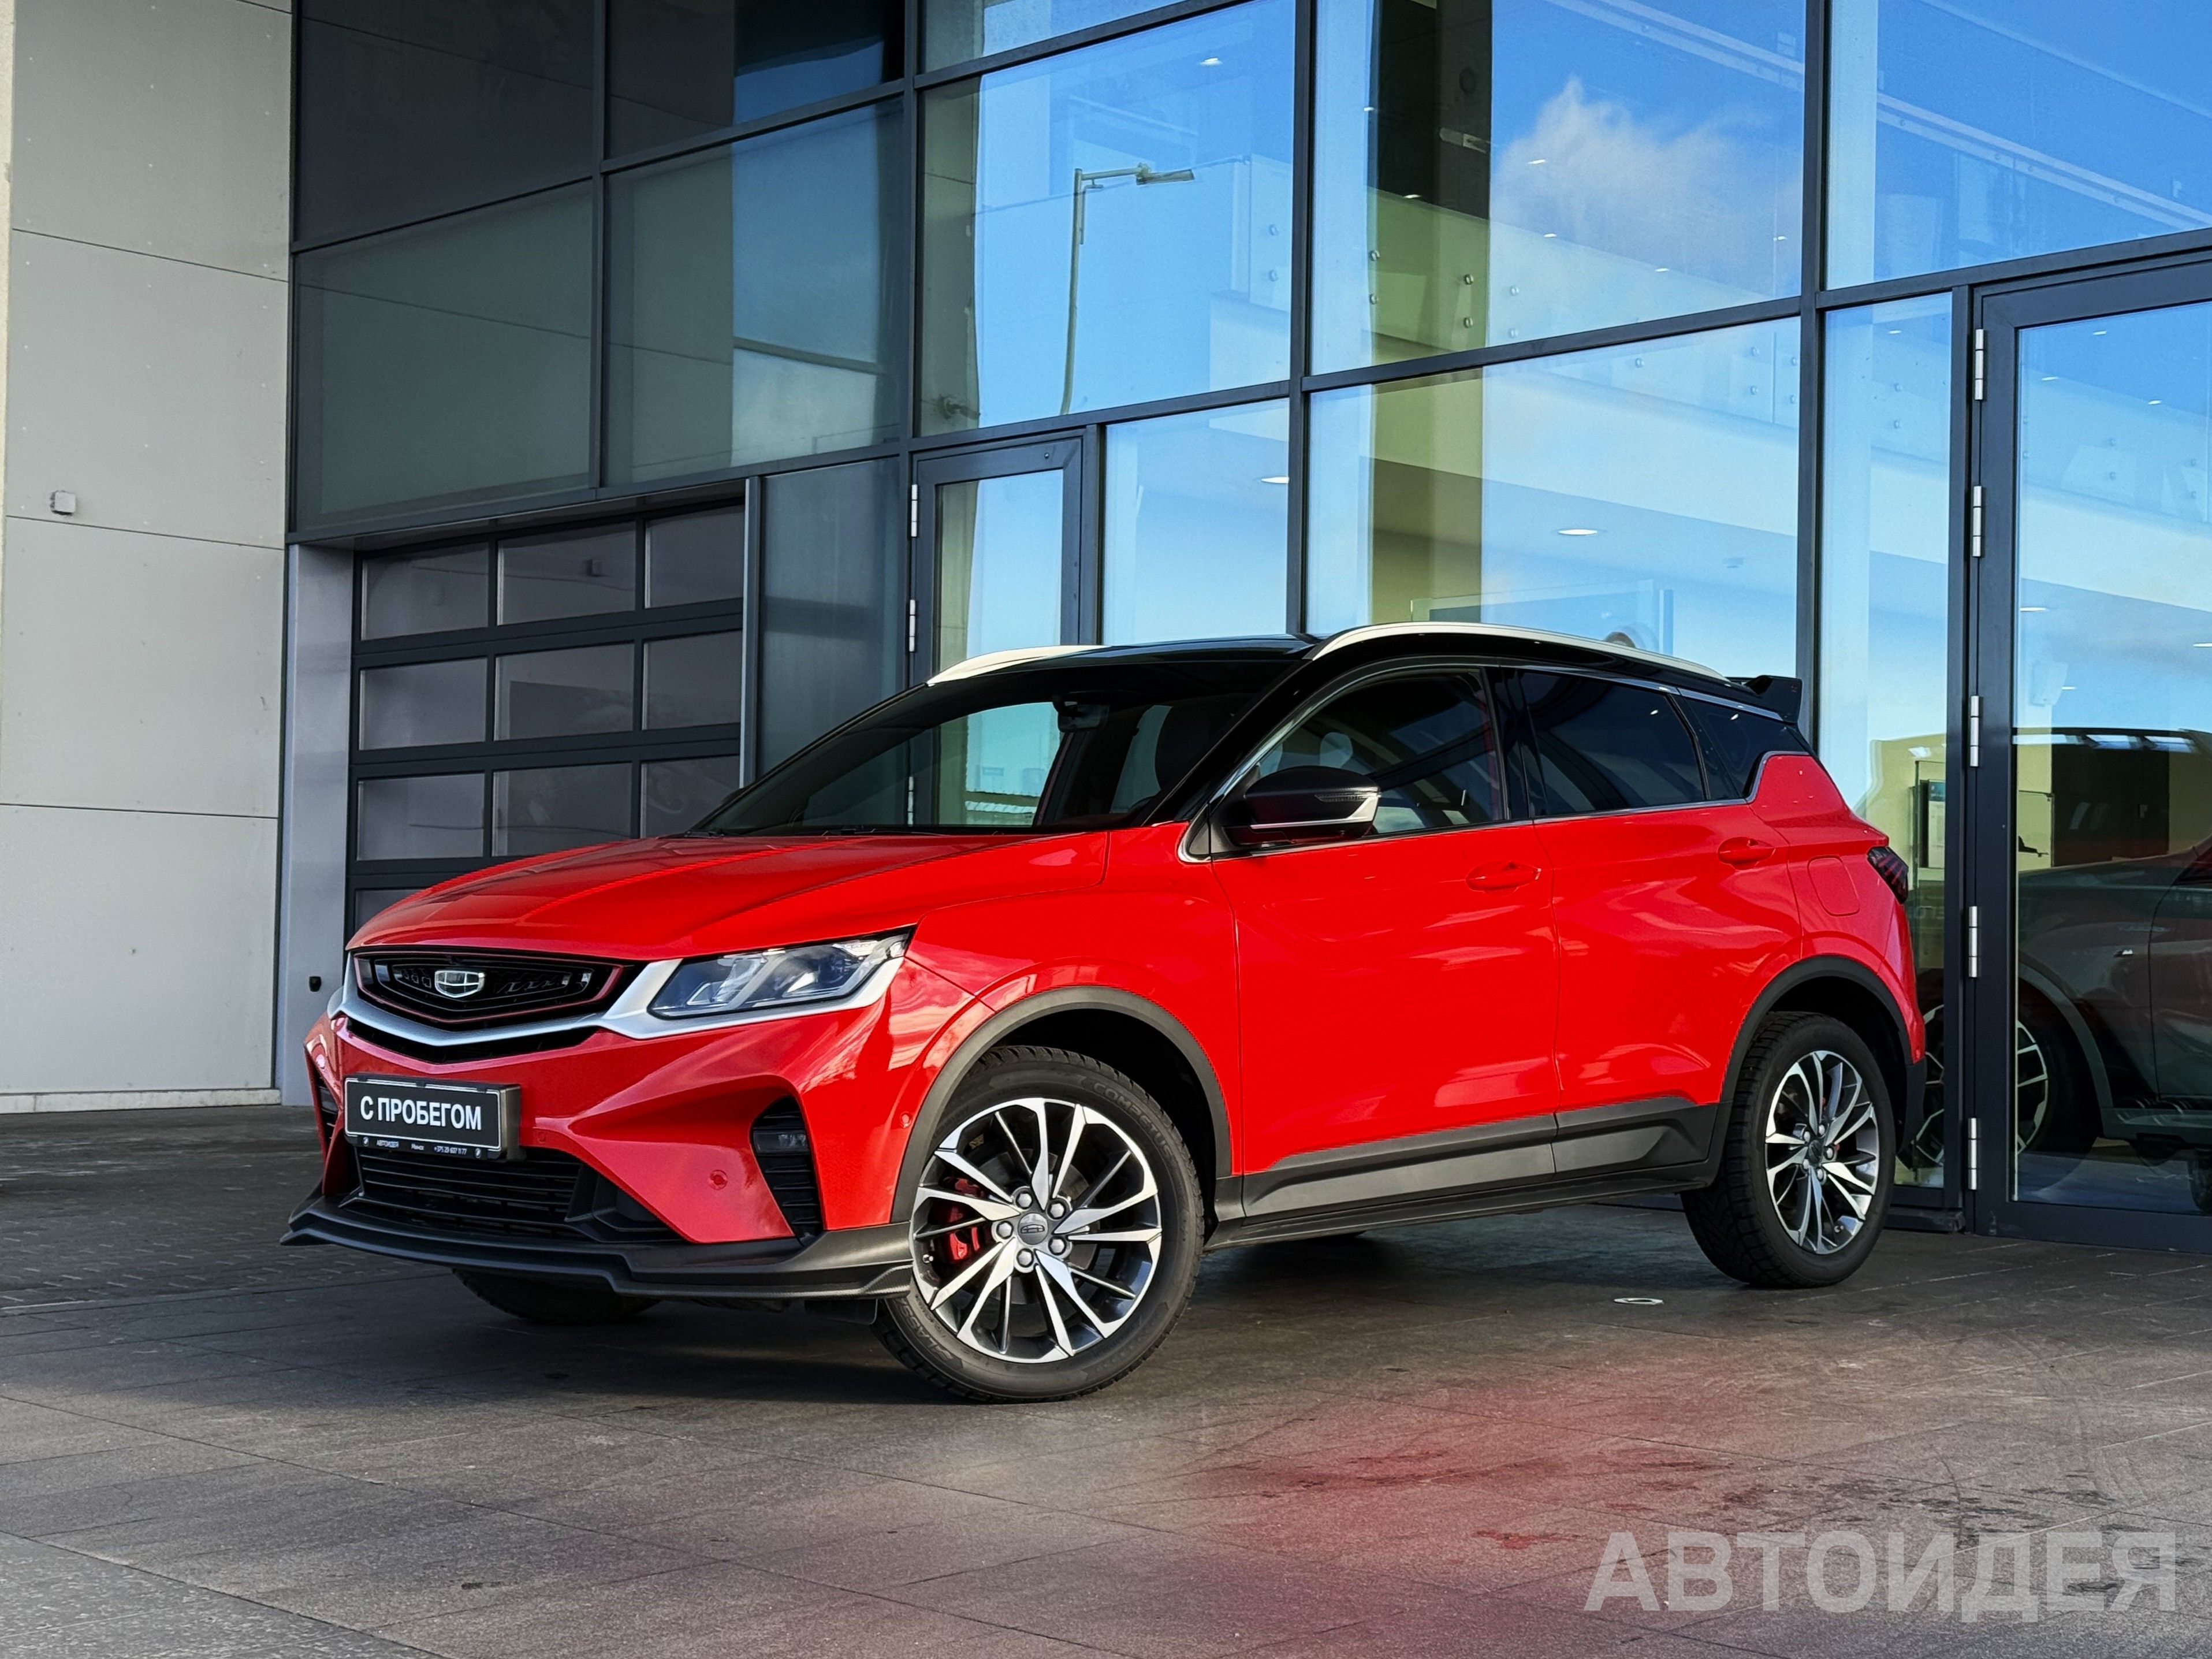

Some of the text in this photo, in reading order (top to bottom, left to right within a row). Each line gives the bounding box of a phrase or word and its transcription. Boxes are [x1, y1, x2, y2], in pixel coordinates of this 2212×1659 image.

[360, 1095, 482, 1131] С ПРОБЕГОМ
[1093, 1083, 1173, 1158] COMPETUS
